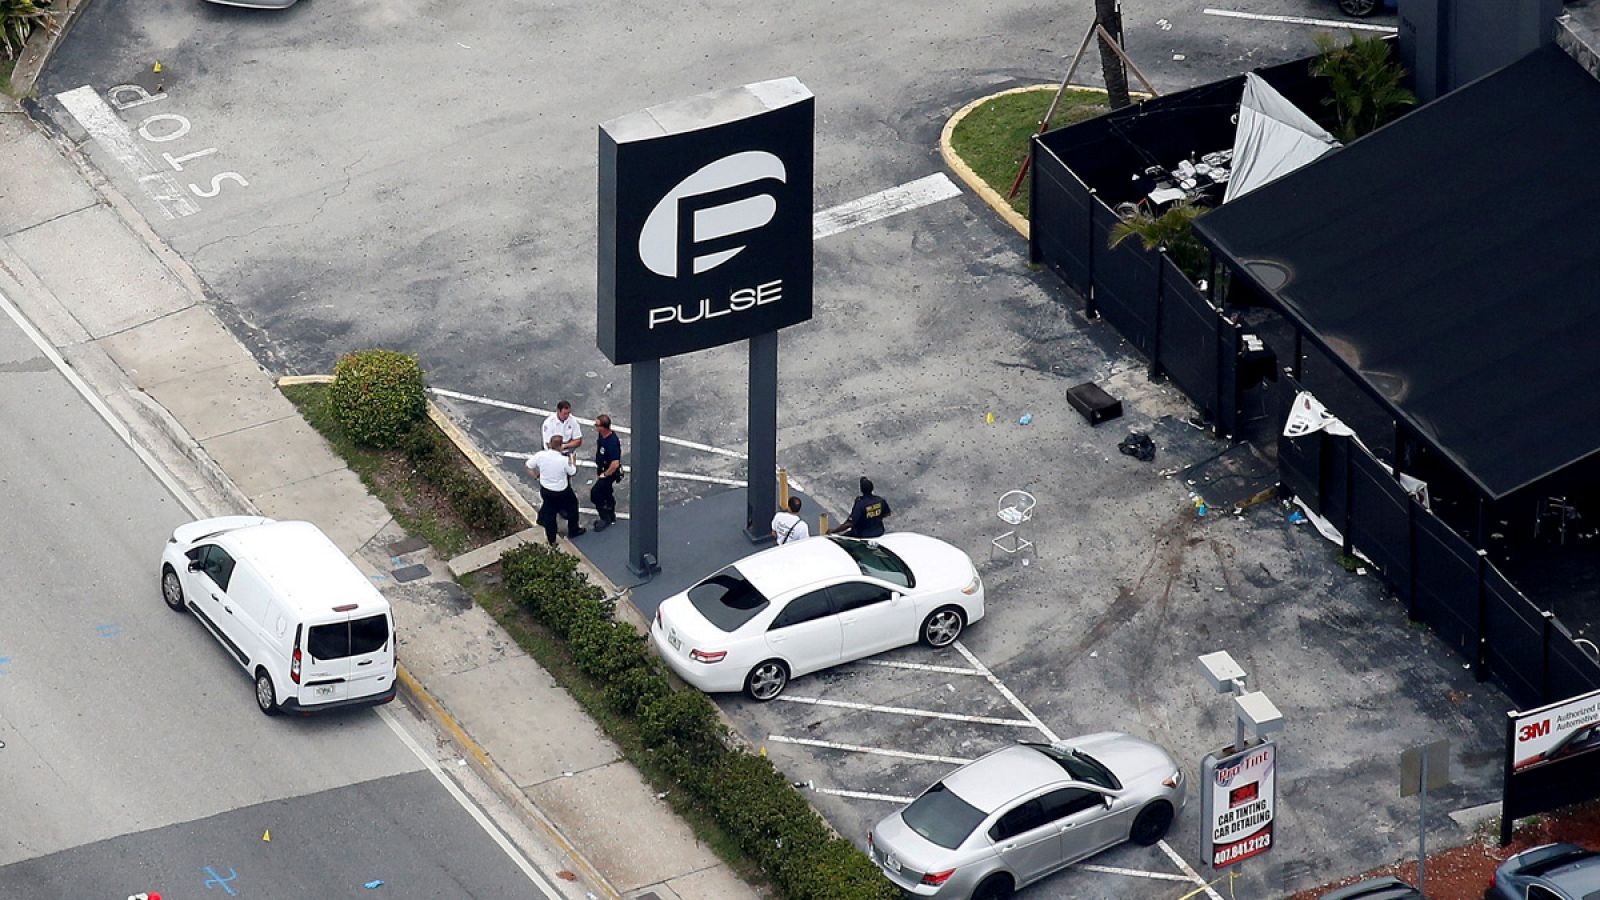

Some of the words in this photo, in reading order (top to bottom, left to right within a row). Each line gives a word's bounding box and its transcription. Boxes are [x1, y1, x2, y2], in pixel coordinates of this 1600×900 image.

[107, 84, 249, 198] STOP
[649, 279, 783, 330] PULSE
[1556, 704, 1596, 722] Authorized
[1556, 713, 1598, 731] Automotive
[1519, 719, 1550, 742] 3M
[1216, 764, 1241, 783] Pro
[1245, 751, 1269, 769] Tint
[1214, 826, 1230, 840] CAR
[1231, 810, 1270, 829] DETAILING
[1218, 811, 1234, 826] CAR
[1236, 799, 1266, 817] TINTING
